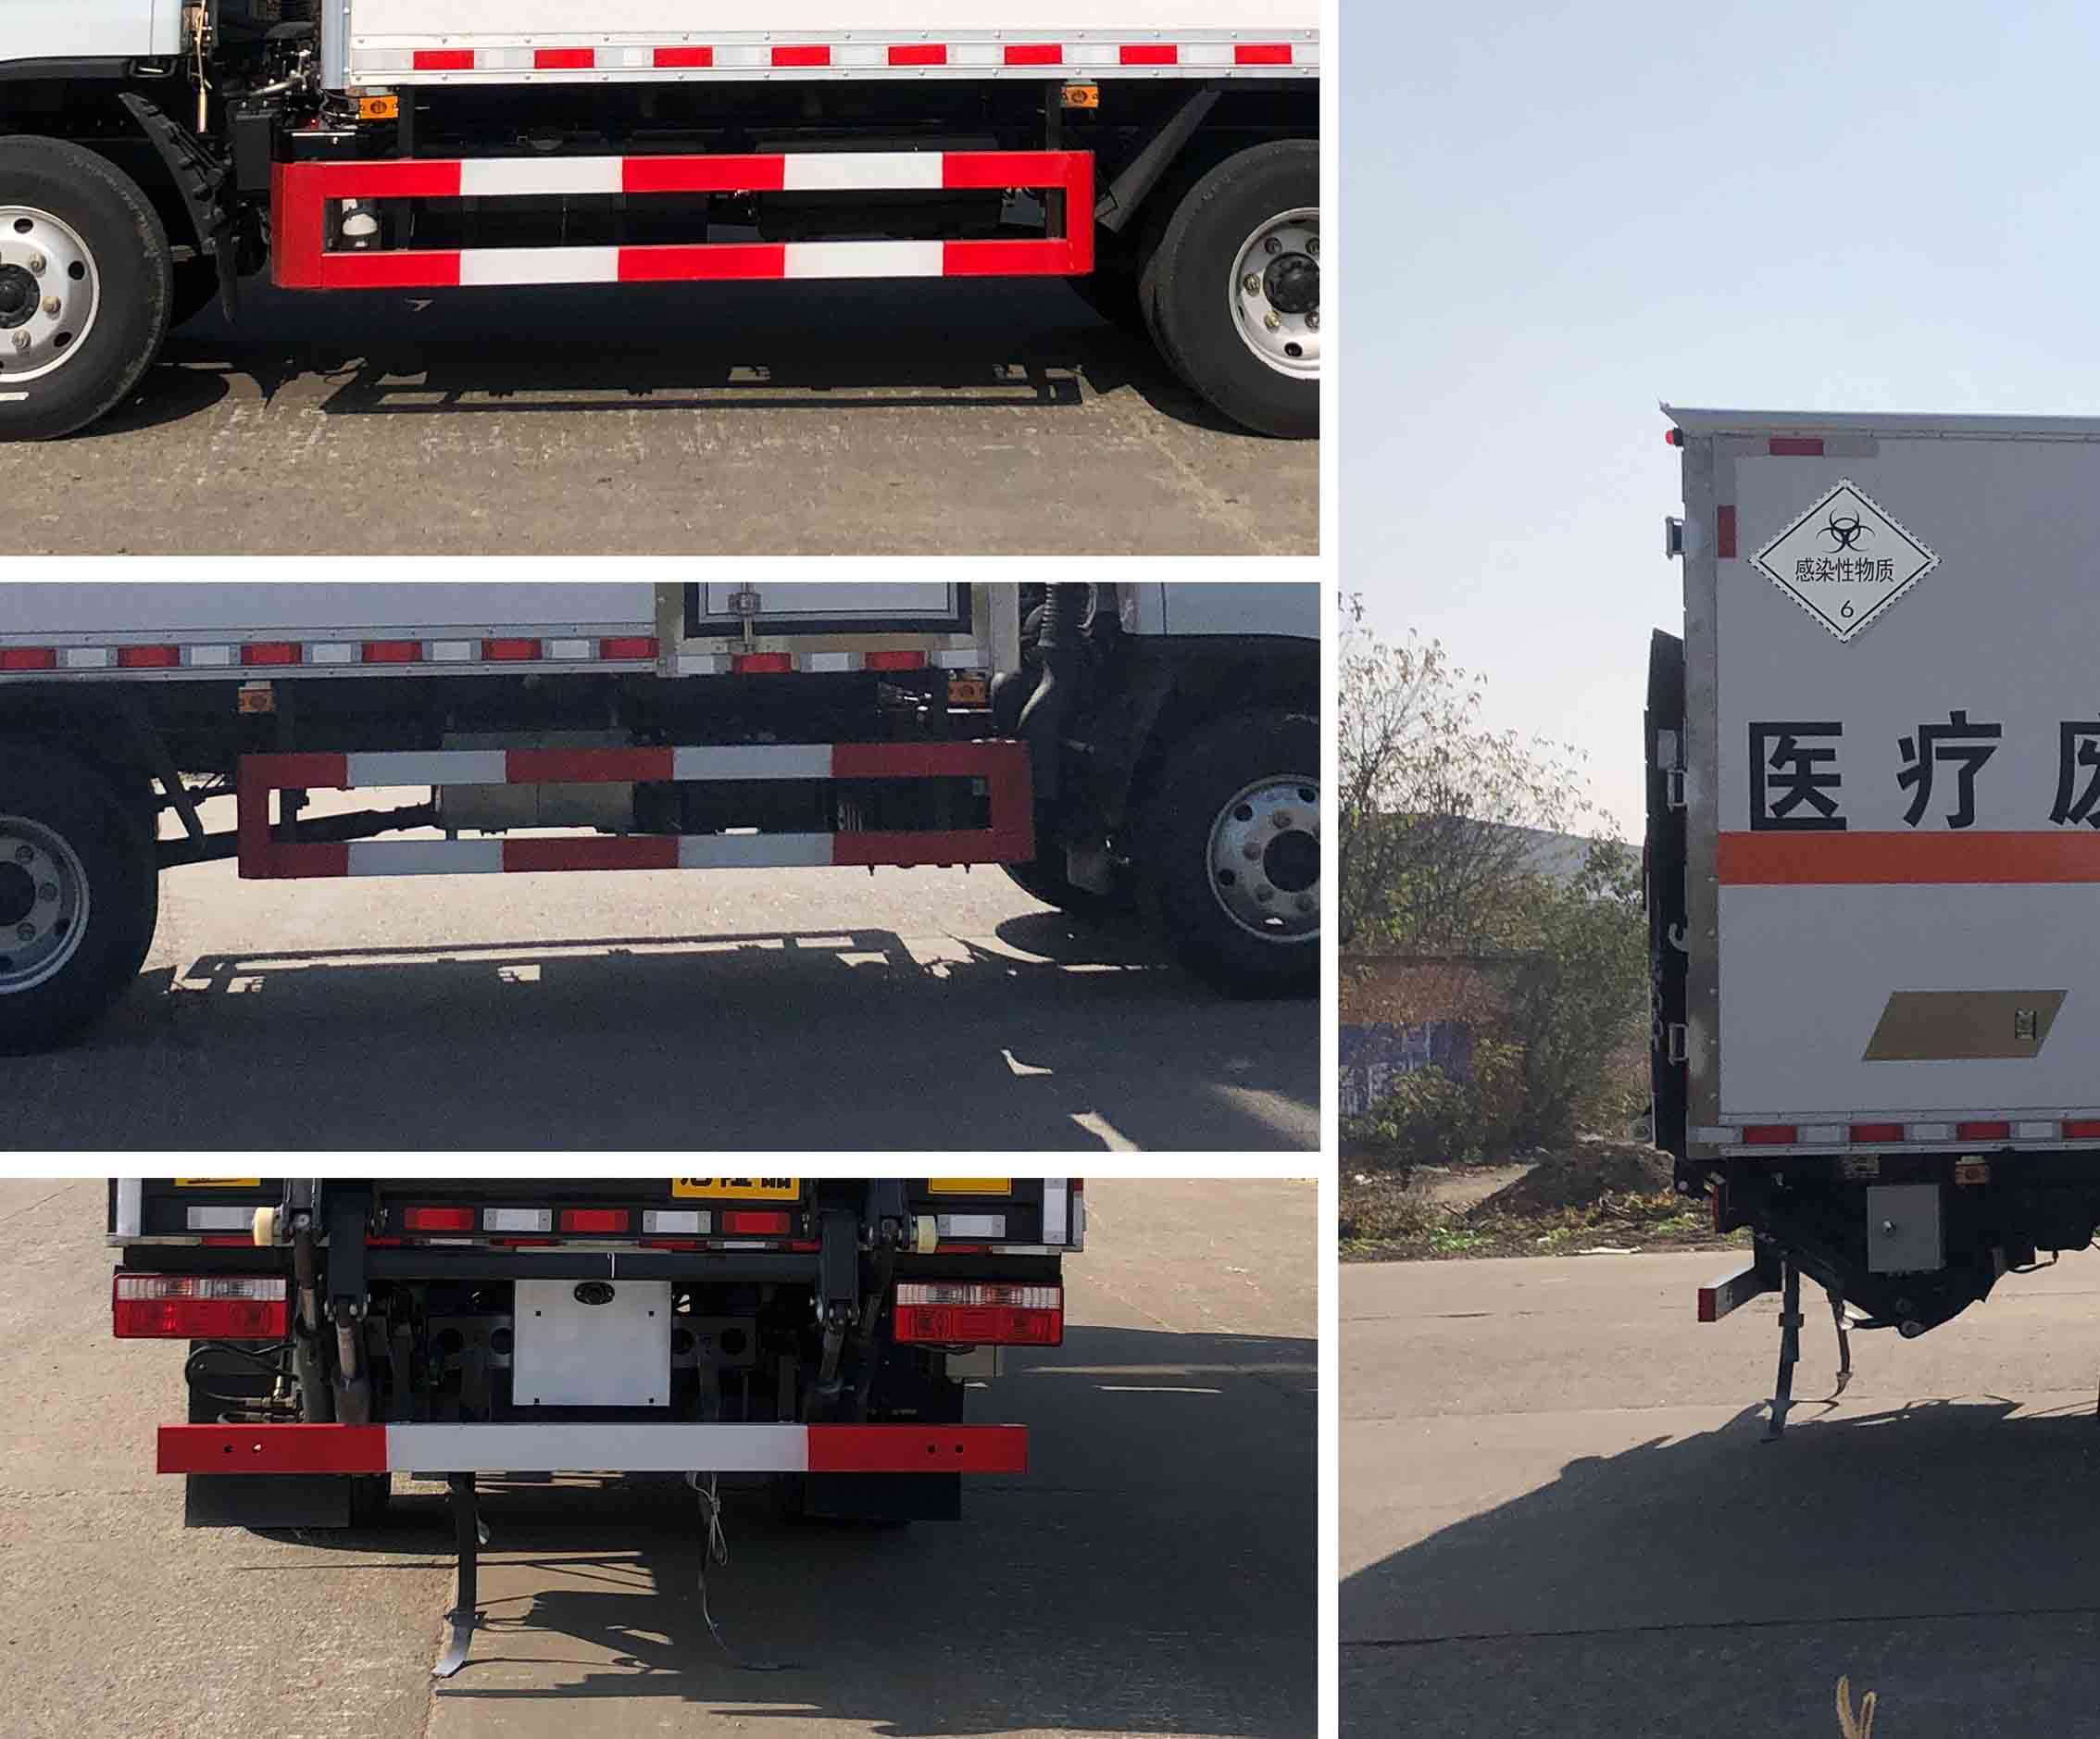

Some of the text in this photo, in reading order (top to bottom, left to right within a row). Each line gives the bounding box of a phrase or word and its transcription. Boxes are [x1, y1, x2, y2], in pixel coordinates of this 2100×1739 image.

[1794, 557, 1894, 583] 感染性物质
[1840, 599, 1855, 619] 6
